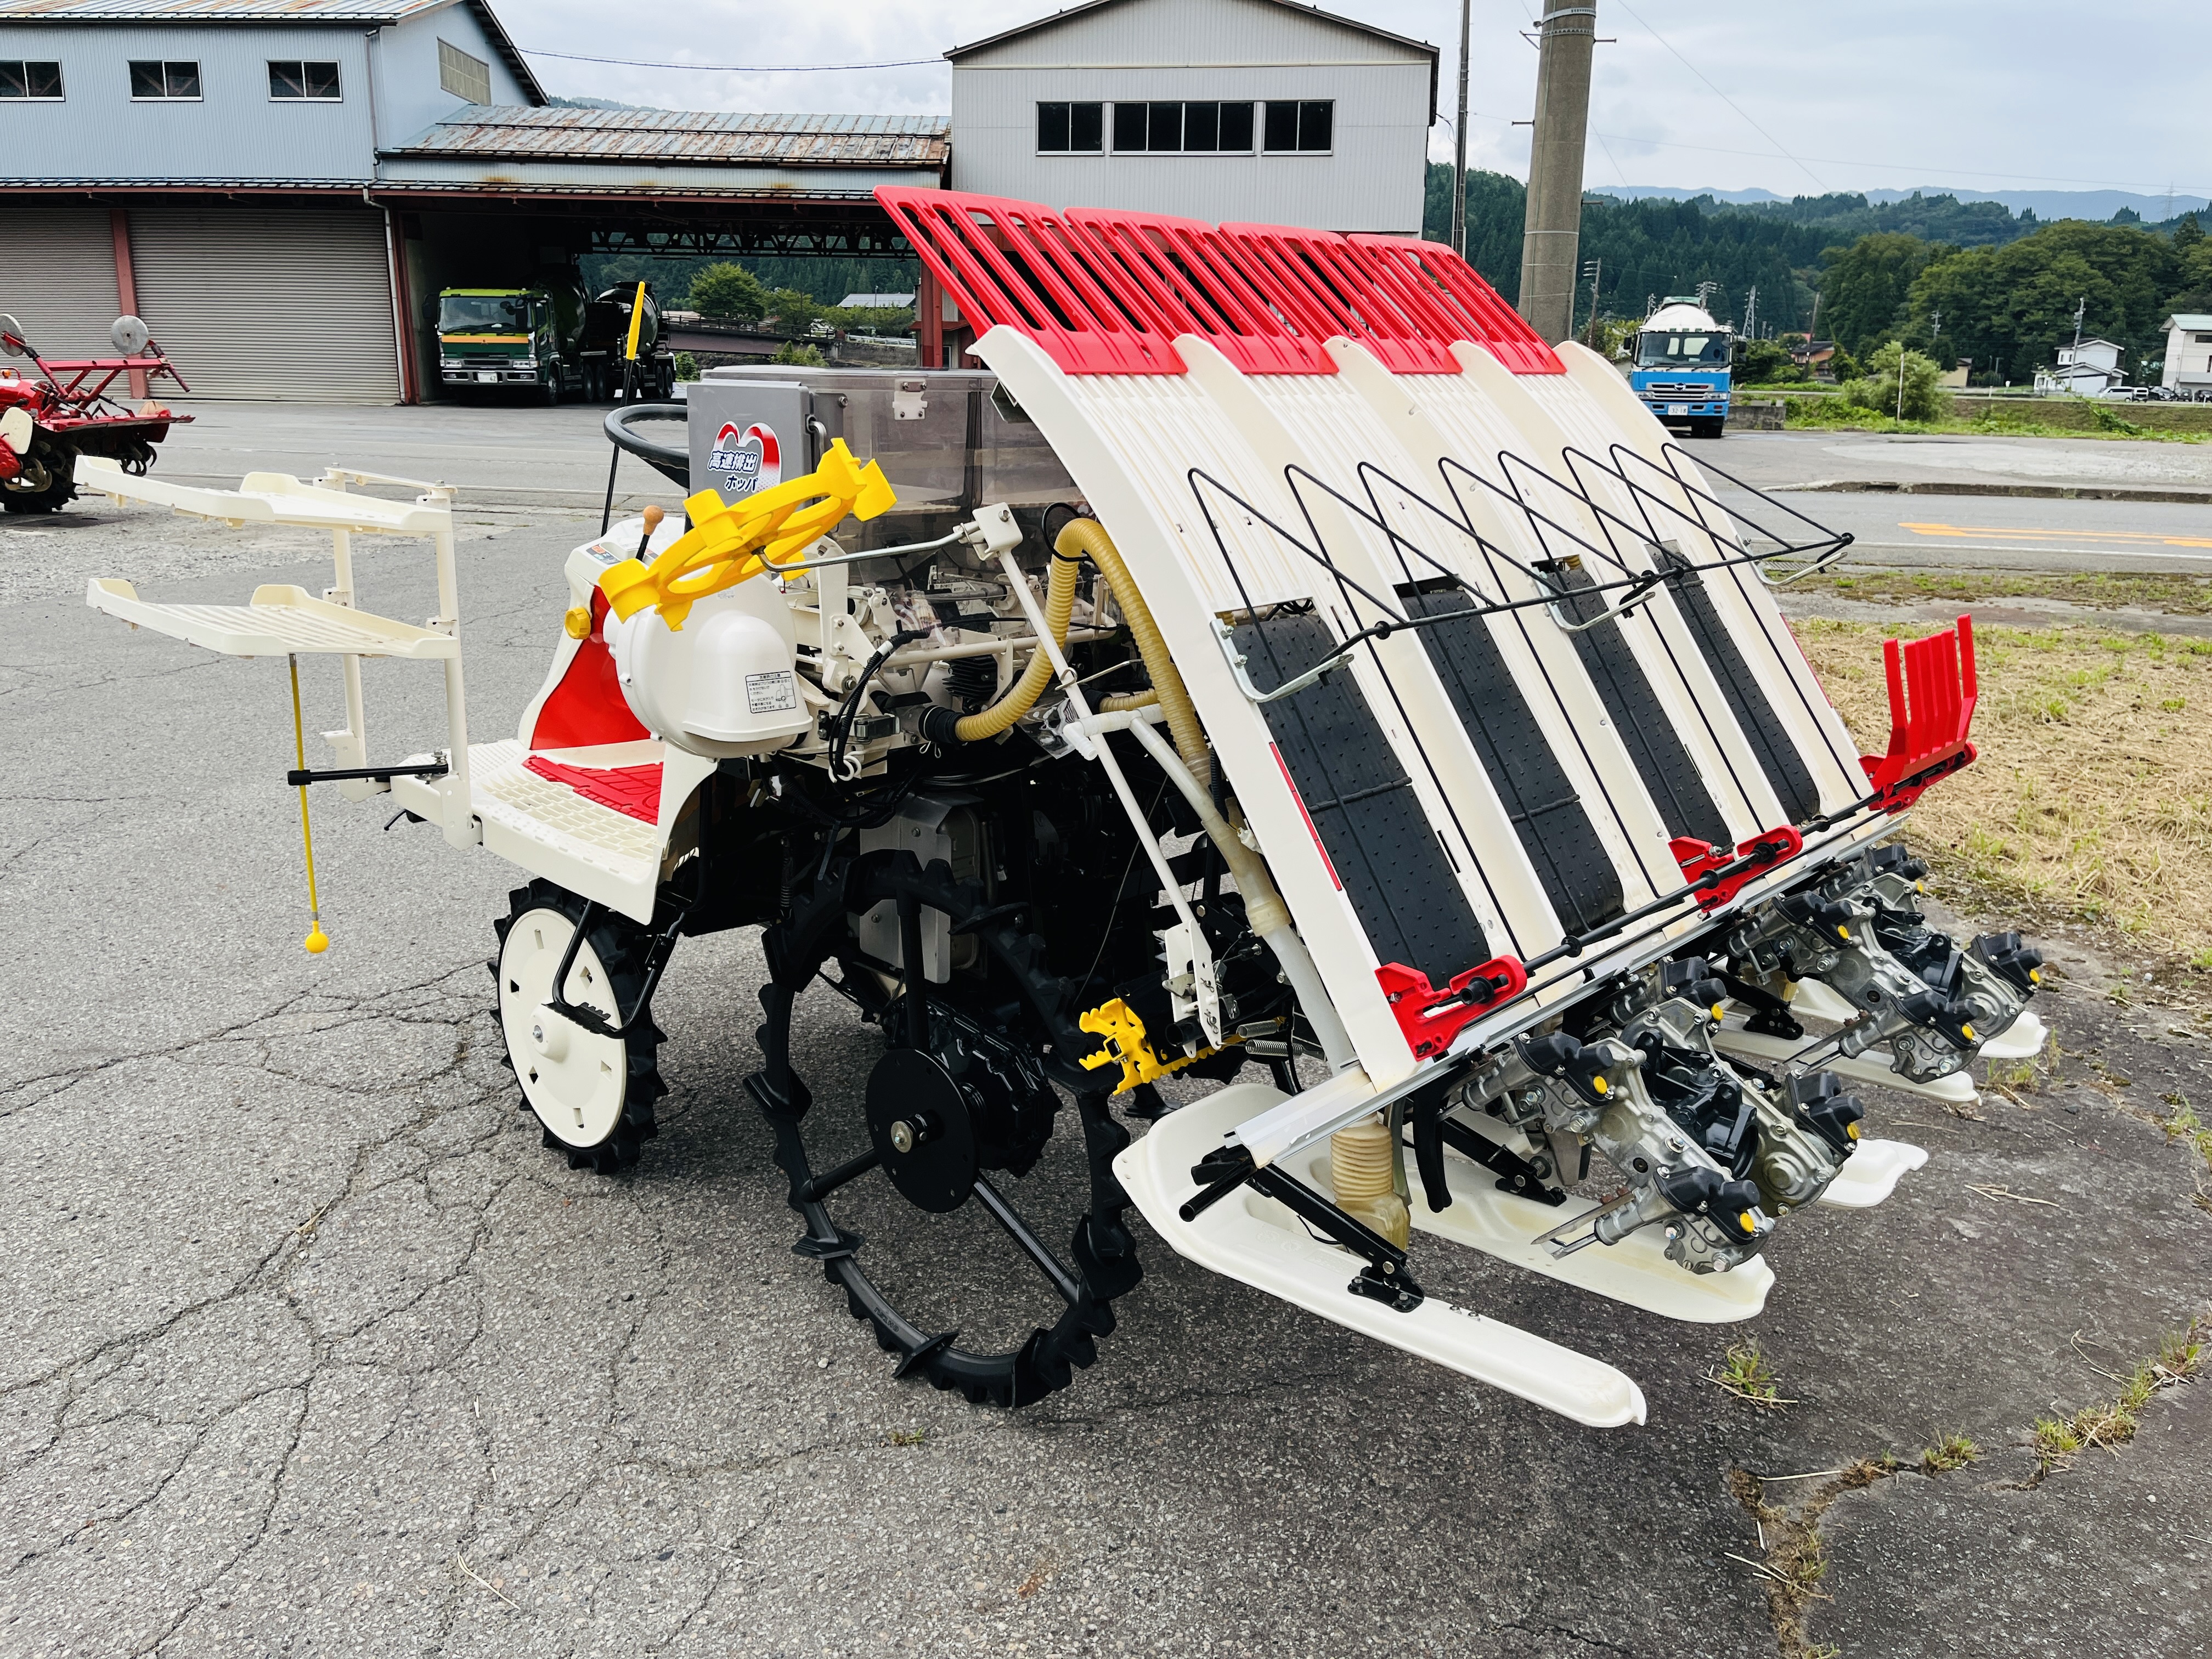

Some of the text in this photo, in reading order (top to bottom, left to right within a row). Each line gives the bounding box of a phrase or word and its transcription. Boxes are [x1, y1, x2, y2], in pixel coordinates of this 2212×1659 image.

[709, 451, 758, 471] 高速排出
[725, 476, 758, 491] ホッパ
